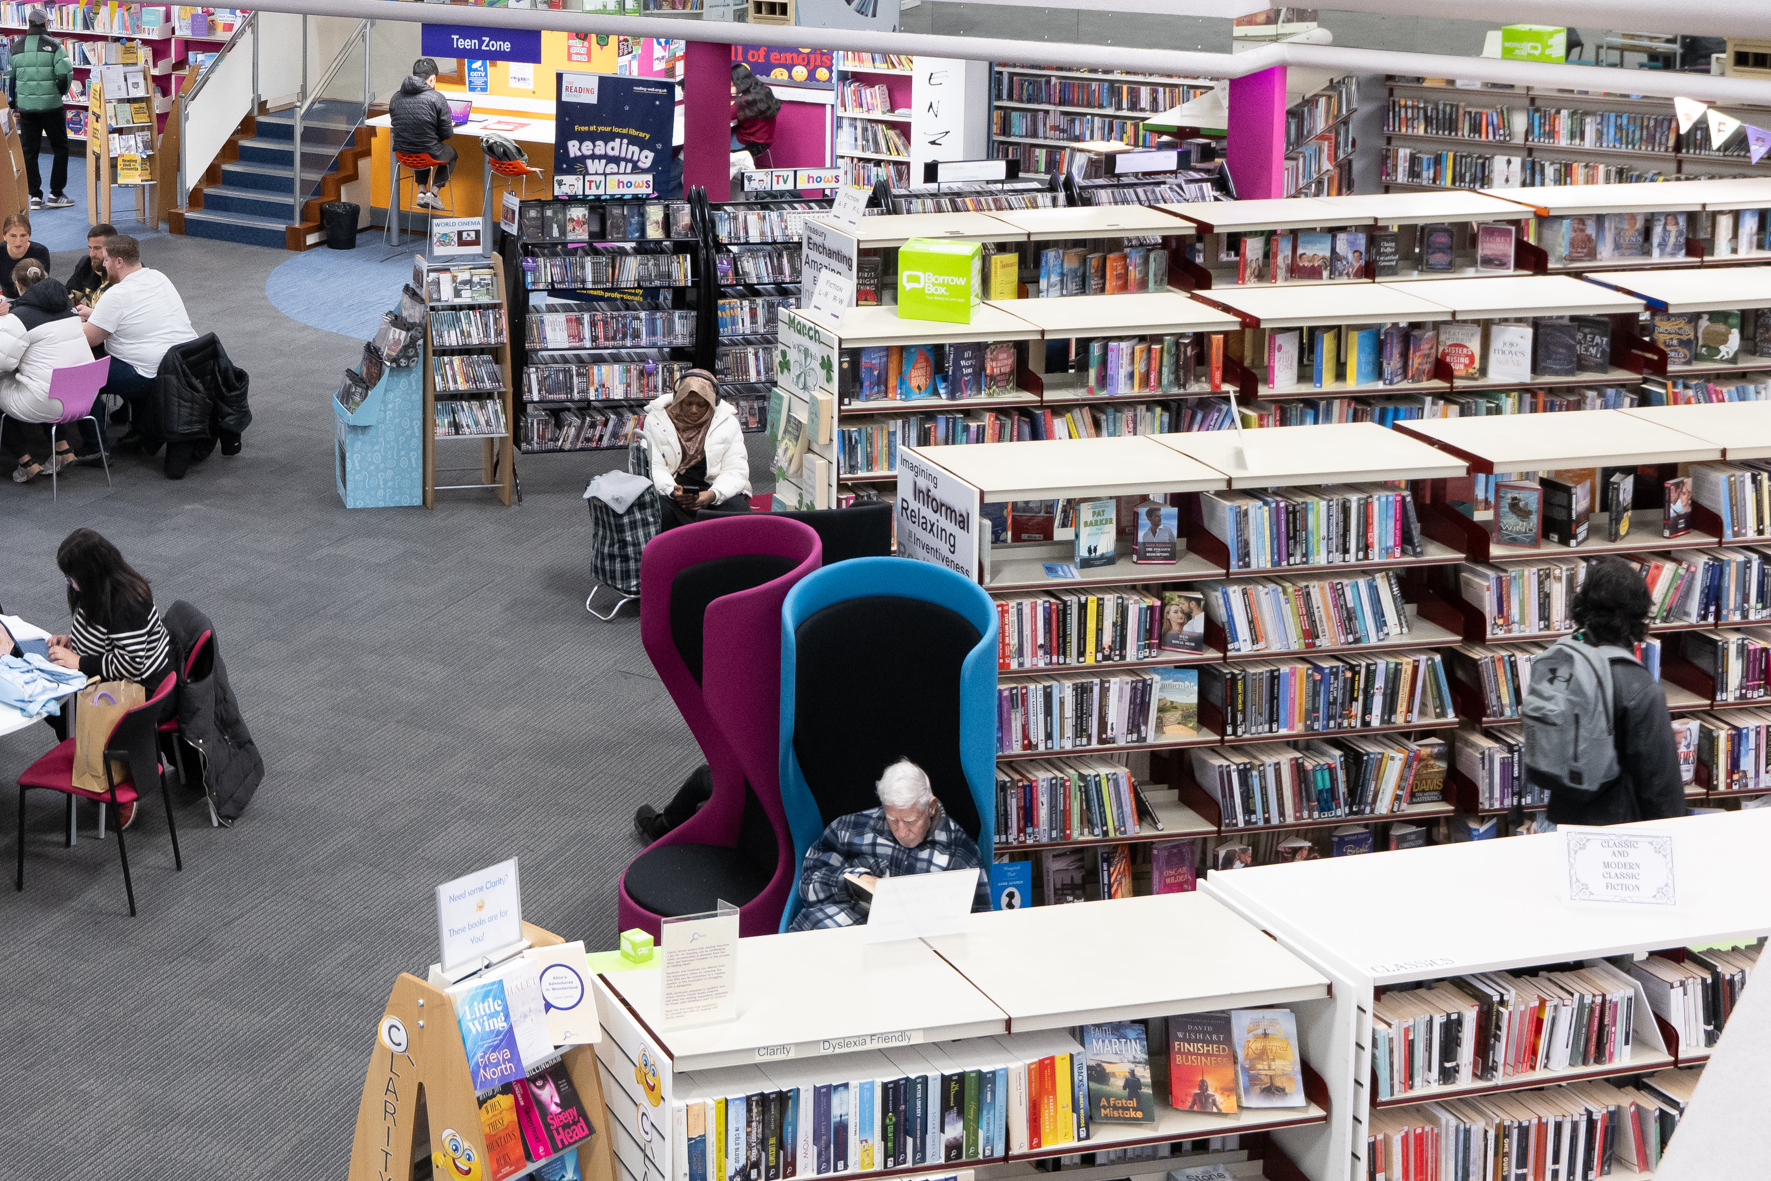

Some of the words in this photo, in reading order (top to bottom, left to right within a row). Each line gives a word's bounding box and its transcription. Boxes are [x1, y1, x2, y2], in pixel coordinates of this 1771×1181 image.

[452, 35, 478, 50] Teen
[481, 37, 511, 51] Zone
[748, 46, 766, 62] of
[770, 49, 832, 69] emojis
[565, 86, 595, 94] READING
[612, 126, 628, 134] local
[629, 127, 650, 139] library
[568, 139, 655, 168] Reading
[585, 159, 632, 174] Well
[587, 179, 601, 191] TV
[608, 176, 651, 190] Shows
[775, 174, 790, 185] TV
[799, 173, 840, 184] Shows
[807, 237, 853, 271] Enchanting
[925, 272, 967, 286] Borrow
[925, 283, 949, 295] Box.
[788, 312, 821, 345] March
[1444, 346, 1472, 354] SISTERS
[1502, 339, 1519, 349] jojo
[1493, 348, 1525, 359] moyes
[960, 358, 976, 366] Were
[911, 369, 930, 377] BANNED
[962, 367, 973, 375] You
[900, 454, 938, 489] Imagining
[914, 480, 970, 534] Informal
[901, 497, 956, 554] Relaxing
[1084, 517, 1113, 527] BARKER
[914, 532, 970, 578] Inventiveness
[1600, 840, 1639, 849] CLASSIC
[1611, 850, 1629, 858] AND
[1164, 867, 1187, 876] OSCAR
[1603, 861, 1640, 870] MODERN
[1602, 872, 1640, 880] CLASSIC
[448, 891, 466, 904] Need
[467, 887, 484, 898] some
[485, 874, 509, 893] Clarity?
[1606, 883, 1640, 892] FICTION
[448, 926, 467, 938] These
[468, 917, 487, 933] books
[488, 915, 498, 926] are
[499, 909, 508, 920] for
[470, 933, 485, 944] You!
[1370, 957, 1454, 974] CLASSICS
[465, 996, 503, 1020] Little
[468, 1012, 507, 1035] Wing
[1188, 1024, 1213, 1032] DAVID
[1091, 1026, 1112, 1039] FAITH
[1177, 1031, 1225, 1041] WISHART
[822, 1037, 867, 1052] Dyslexia
[870, 1031, 912, 1046] Friendly
[1093, 1039, 1141, 1055] MARTIN
[1174, 1041, 1228, 1055] FINISHED
[478, 1048, 511, 1067] Freya
[757, 1045, 791, 1058] Clarity
[1176, 1054, 1228, 1067] BUSINESS
[480, 1061, 515, 1081] North
[484, 1099, 502, 1116] WHEN
[1100, 1098, 1108, 1107] A
[1110, 1097, 1137, 1108] Fatal
[547, 1106, 578, 1130] Sleepy
[1101, 1107, 1143, 1118] Mistake
[487, 1117, 505, 1133] THESE
[523, 1106, 540, 1143] Sleepyhead
[553, 1118, 588, 1148] Head
[495, 1152, 511, 1168] BURN
[1186, 1171, 1226, 1181] Stone
